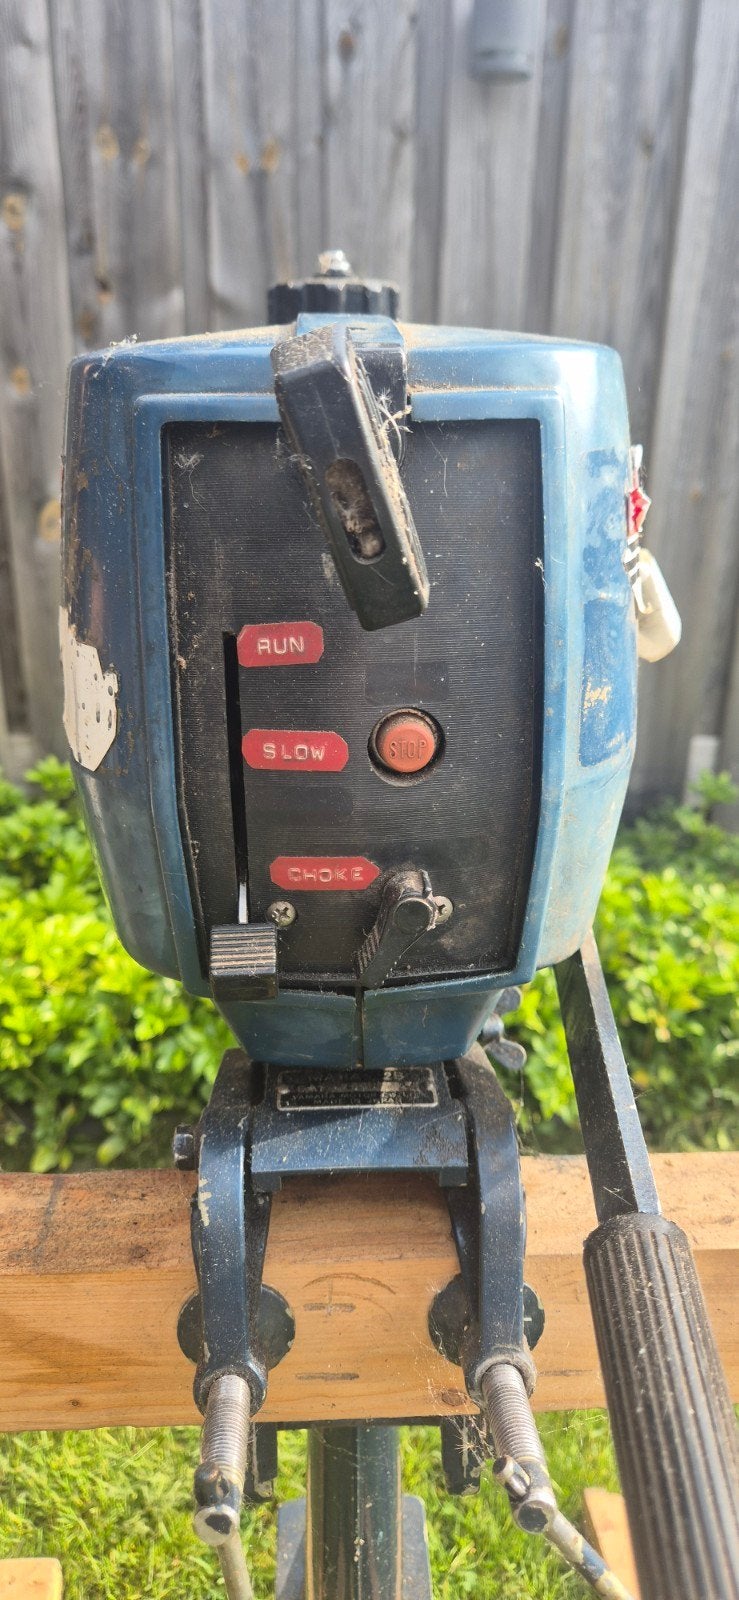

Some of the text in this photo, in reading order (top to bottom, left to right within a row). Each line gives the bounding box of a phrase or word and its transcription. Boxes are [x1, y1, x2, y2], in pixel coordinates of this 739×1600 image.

[256, 636, 305, 655] RUN
[262, 742, 326, 760] SLOW
[388, 741, 427, 760] STOP
[287, 866, 365, 882] CHOKE
